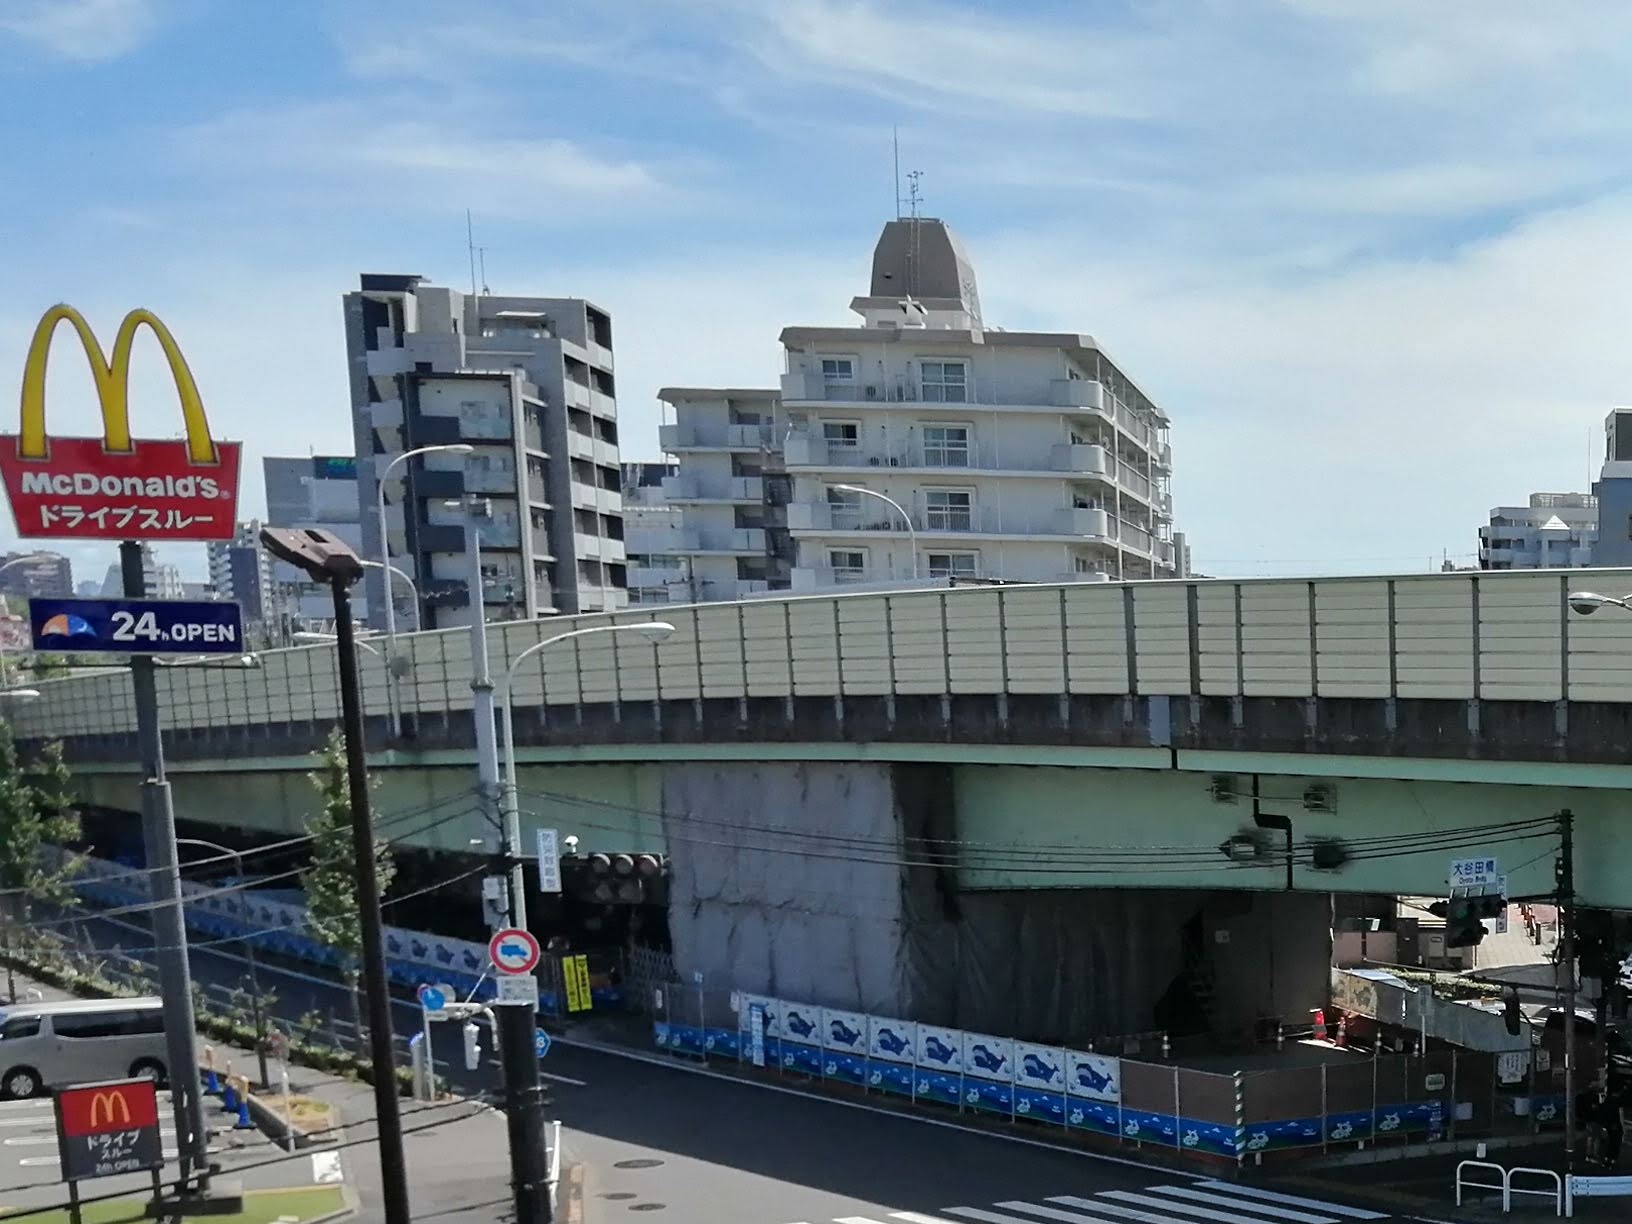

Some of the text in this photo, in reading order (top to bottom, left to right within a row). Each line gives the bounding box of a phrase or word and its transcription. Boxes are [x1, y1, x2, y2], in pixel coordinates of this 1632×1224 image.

[22, 472, 219, 498] McDonald's
[40, 504, 213, 530] ドライブスルー
[171, 623, 235, 643] OPEN
